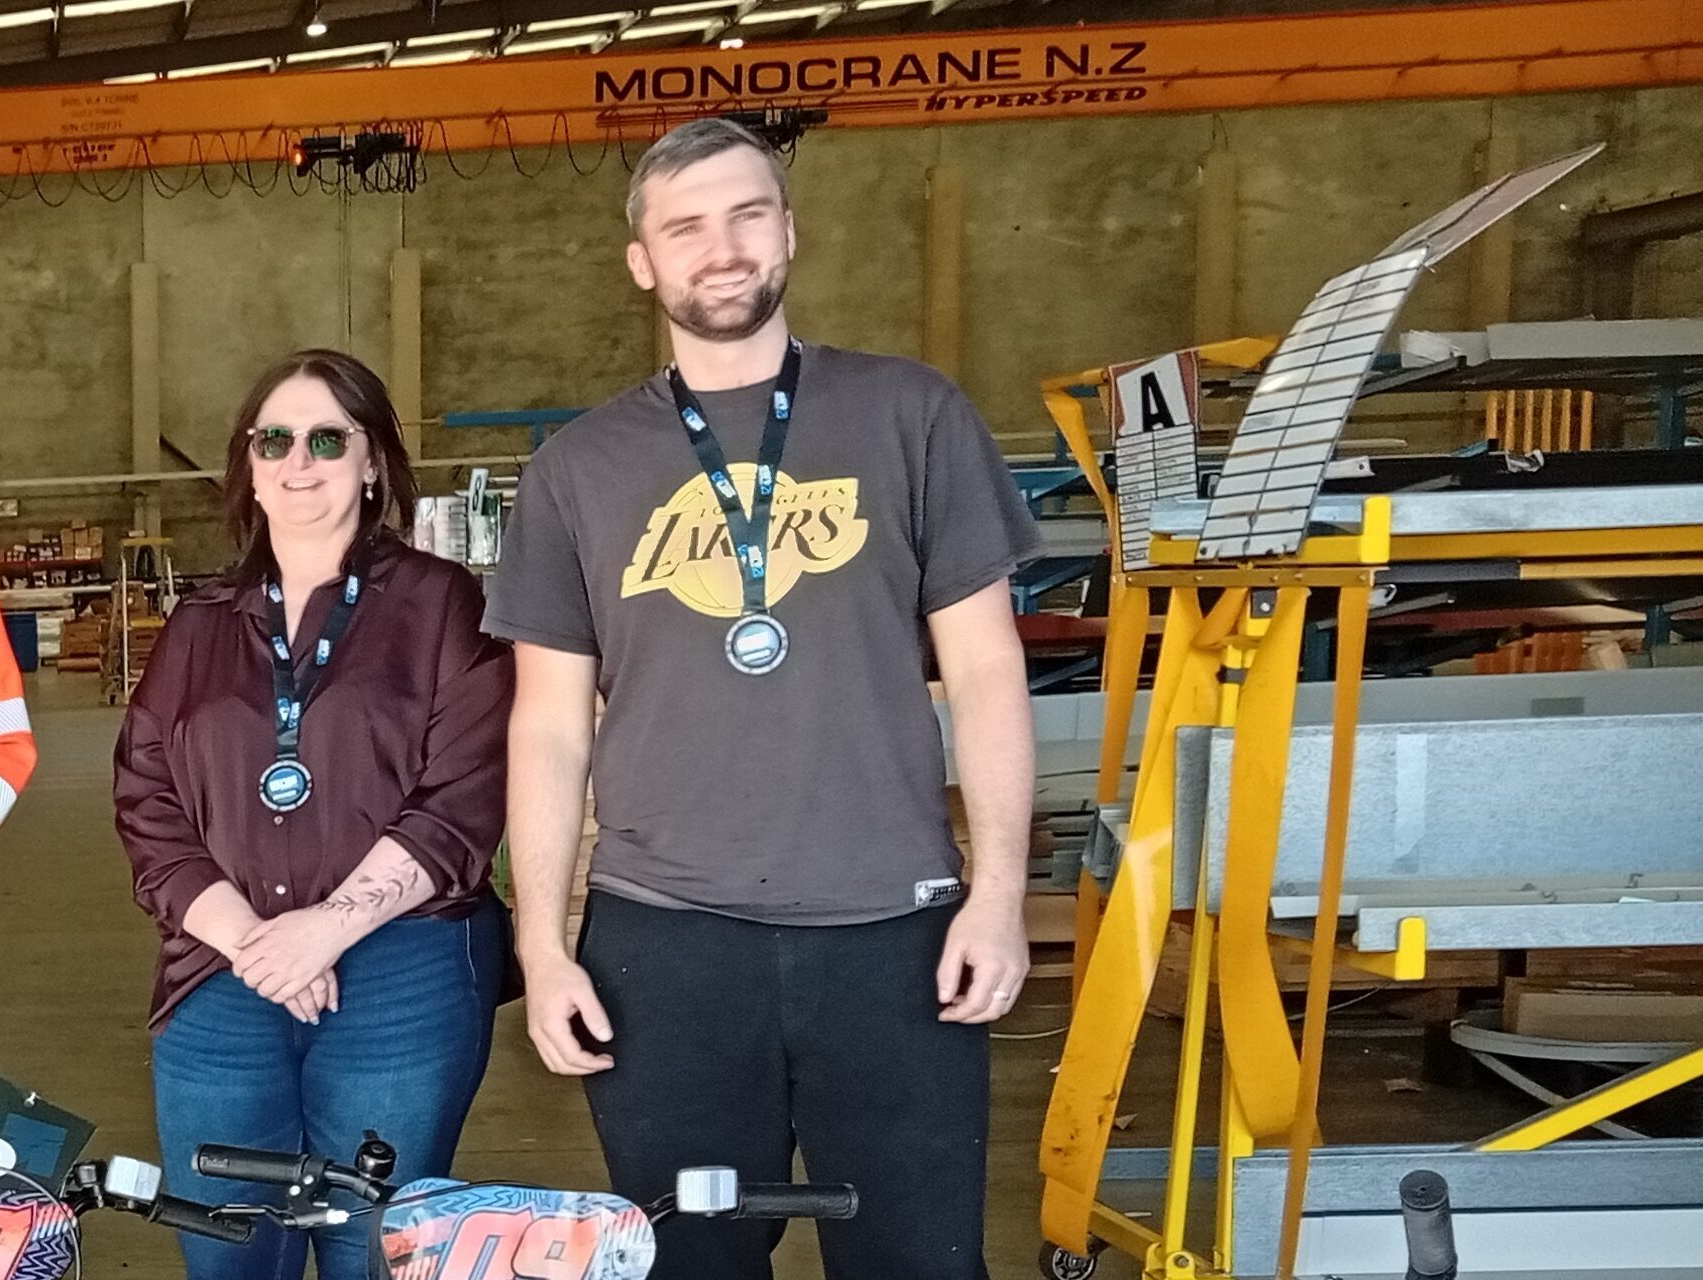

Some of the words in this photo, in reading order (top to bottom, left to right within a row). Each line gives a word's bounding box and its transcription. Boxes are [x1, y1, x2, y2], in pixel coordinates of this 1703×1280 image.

[595, 47, 1022, 104] MONOCRANE
[1045, 41, 1147, 78] N.Z
[924, 86, 1147, 112] HYPERSPEED
[1140, 371, 1176, 432] A
[639, 503, 845, 583] LAKRS
